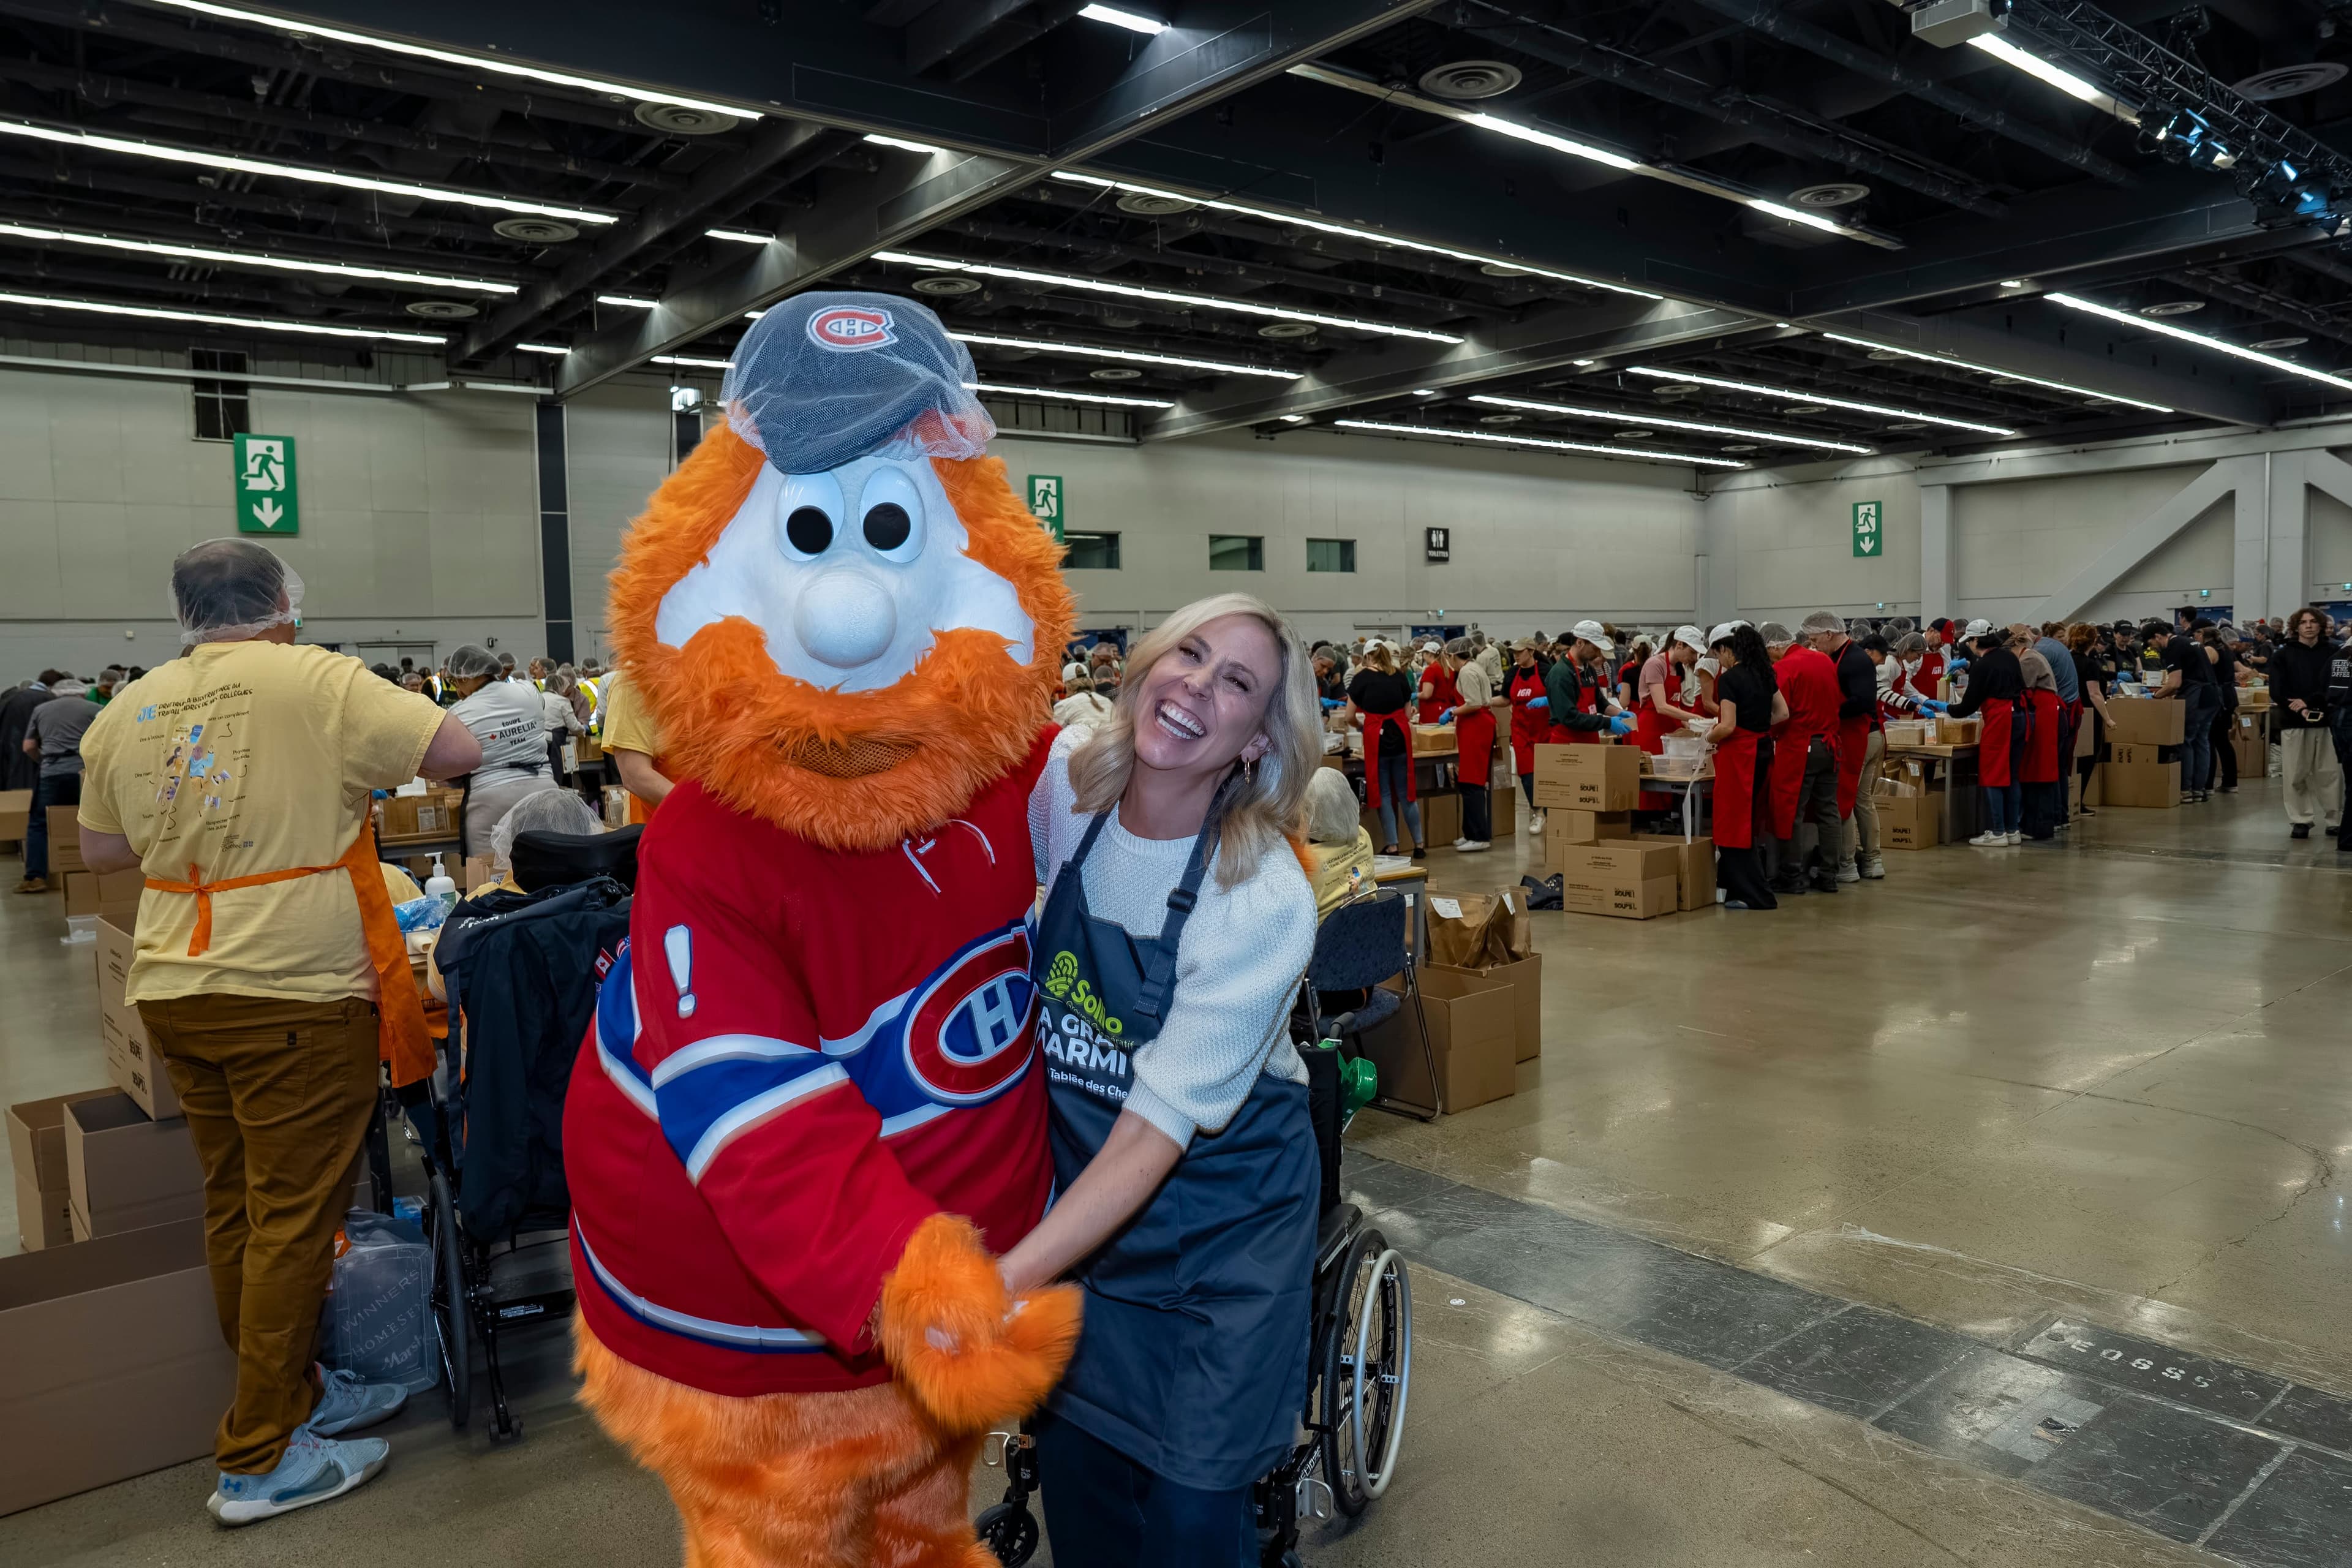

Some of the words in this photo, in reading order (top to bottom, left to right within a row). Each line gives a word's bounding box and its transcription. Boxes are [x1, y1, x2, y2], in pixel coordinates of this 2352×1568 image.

[1517, 688, 1532, 697] IGA
[137, 704, 157, 723] JE
[499, 723, 537, 739] AURELIA
[510, 737, 526, 746] TEAM
[1039, 1006, 1052, 1031] A
[1061, 1014, 1115, 1047] GRA
[1037, 1027, 1127, 1076] ARMI
[1085, 1079, 1106, 1093] des
[1107, 1085, 1128, 1099] Che
[342, 1269, 419, 1333] WINNERS
